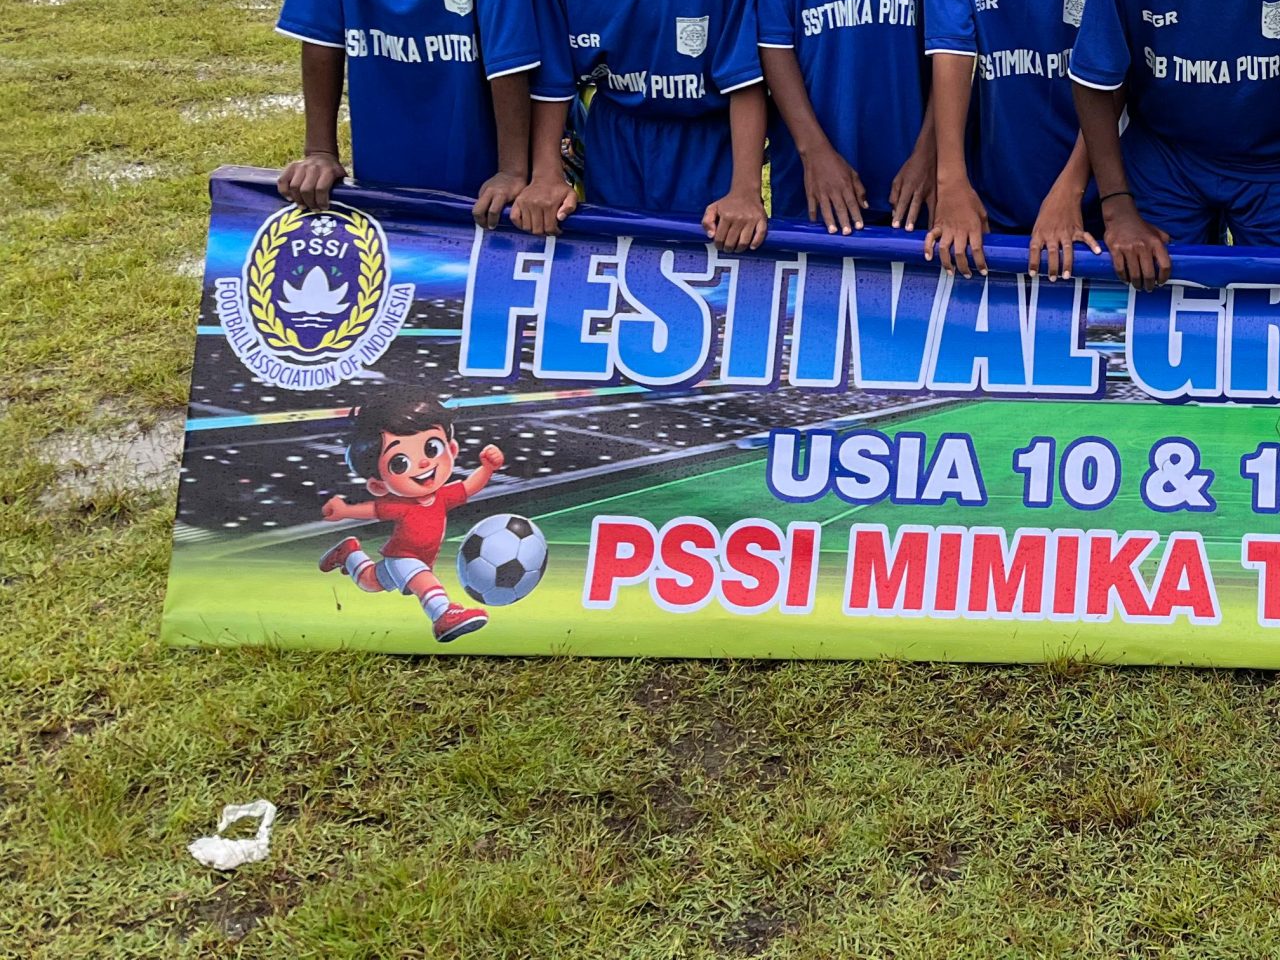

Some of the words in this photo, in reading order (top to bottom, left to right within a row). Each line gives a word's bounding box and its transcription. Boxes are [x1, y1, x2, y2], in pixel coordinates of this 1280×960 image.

[1142, 10, 1178, 27] EGR
[424, 33, 479, 62] PUTRA
[993, 49, 1044, 78] TIMIKA
[1173, 56, 1231, 83] TIMIKA
[291, 238, 349, 259] PSSI
[458, 224, 1102, 397] FESTIVAL
[219, 281, 252, 353] FOOTBALL
[247, 348, 342, 387] ASSOCIATION
[339, 354, 361, 376] OF
[360, 286, 411, 361] INDONESIA
[768, 430, 988, 508] USIA
[1014, 437, 1122, 512] 10
[1142, 441, 1214, 512] &
[584, 517, 822, 615] PSSI
[844, 525, 1221, 625] MIMIKA
